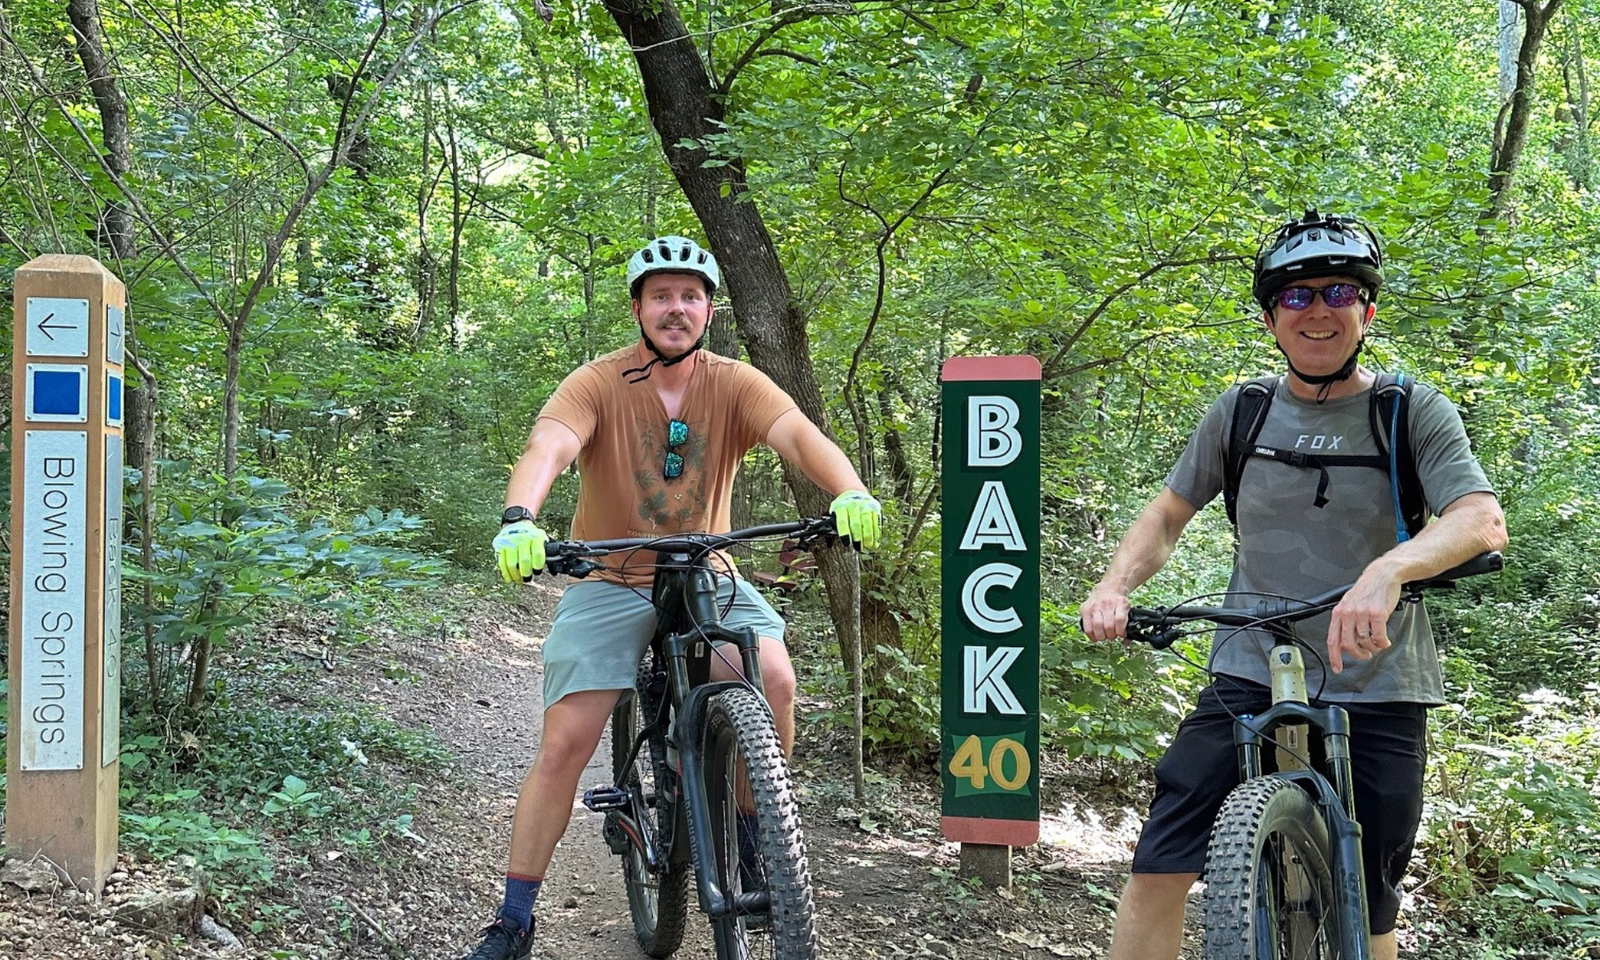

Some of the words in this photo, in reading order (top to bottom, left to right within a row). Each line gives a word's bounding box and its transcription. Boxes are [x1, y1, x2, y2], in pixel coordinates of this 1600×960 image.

[1294, 434, 1343, 450] FOX
[35, 457, 75, 593] Blowing
[959, 395, 1028, 715] BACK
[33, 611, 73, 744] Springs
[107, 628, 117, 678] 40
[949, 734, 1031, 790] 40
